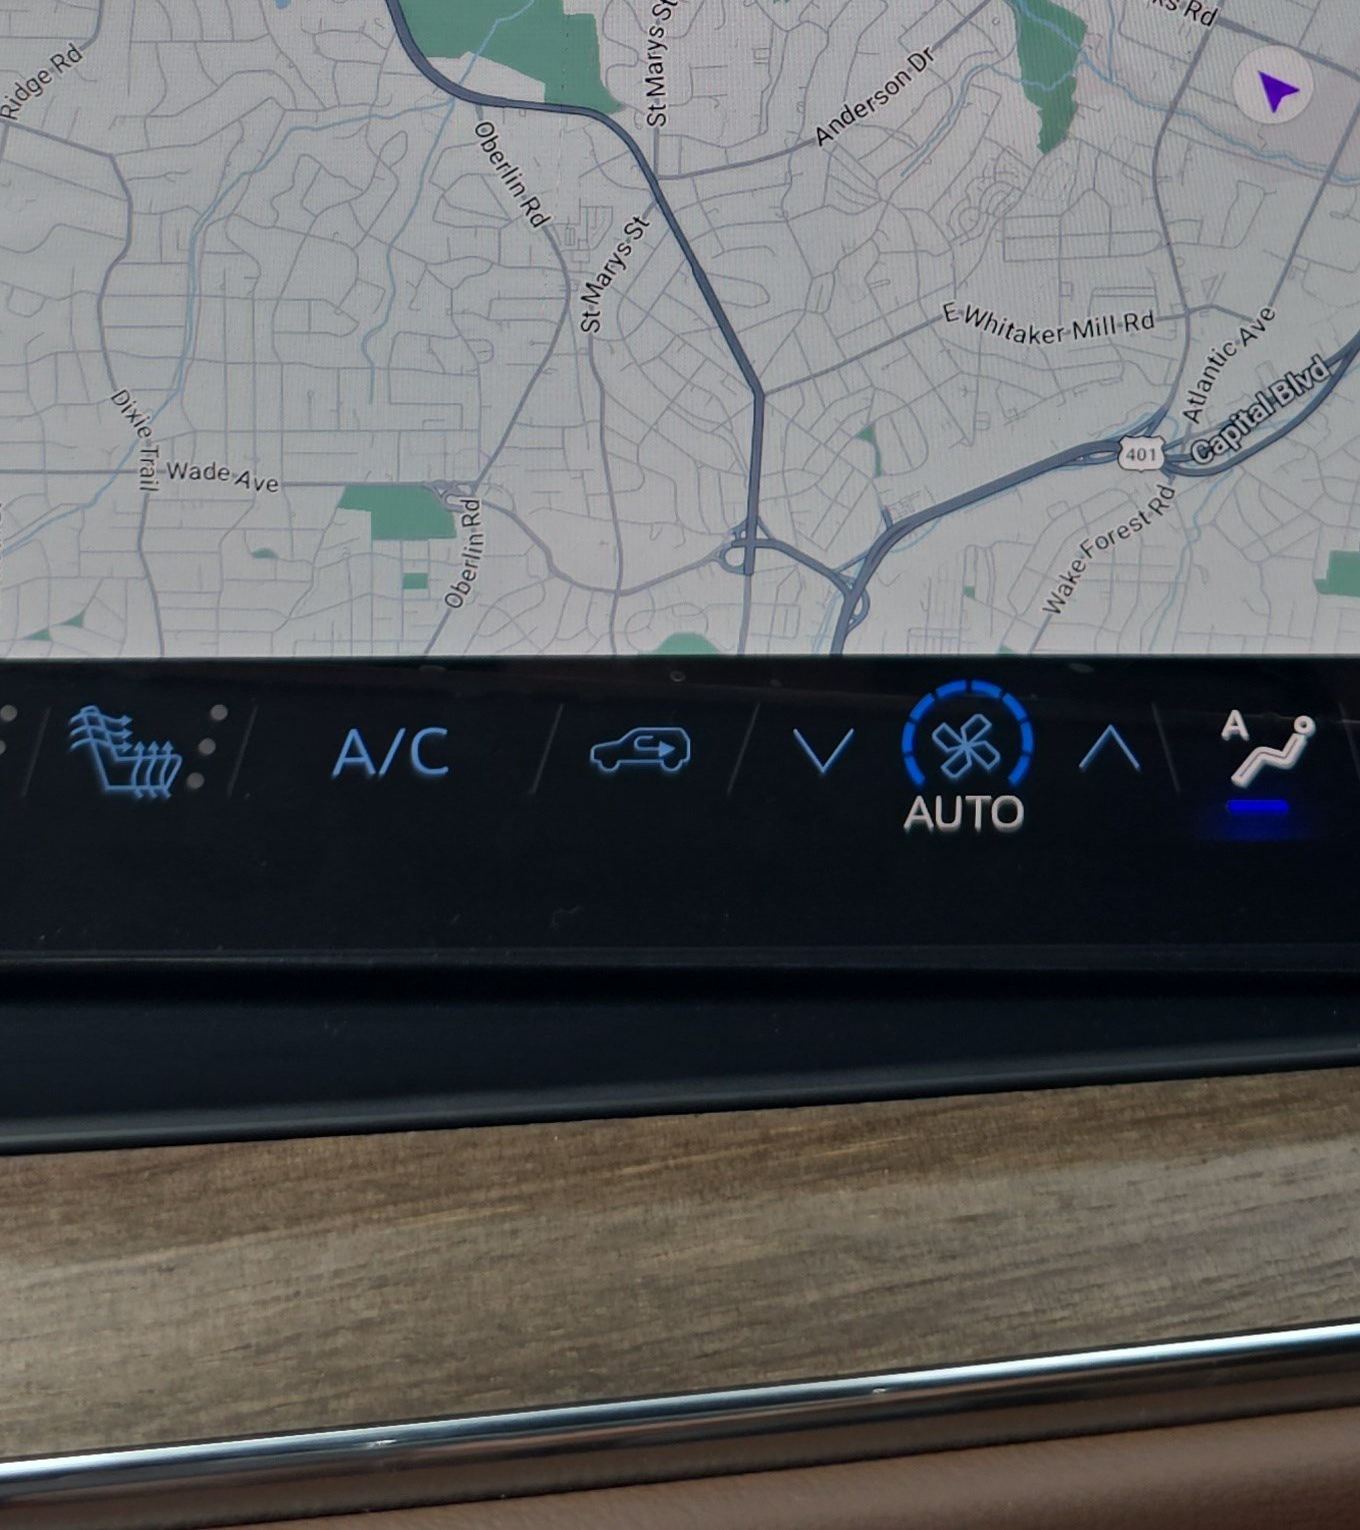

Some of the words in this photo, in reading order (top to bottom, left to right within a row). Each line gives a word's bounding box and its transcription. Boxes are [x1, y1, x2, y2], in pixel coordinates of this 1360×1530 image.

[1183, 0, 1218, 26] Rd
[0, 67, 46, 121] Ridge
[49, 44, 84, 78] Rd
[647, 26, 669, 98] Marys
[646, 102, 668, 128] St
[815, 72, 913, 147] Anderson
[906, 46, 935, 79] Dr
[476, 122, 527, 198] Oberlin
[520, 196, 549, 229] Rd
[623, 216, 651, 241] St
[581, 242, 632, 306] Marys
[581, 310, 602, 334] St
[942, 302, 959, 324] E
[965, 306, 1065, 345] Whitaker
[1072, 315, 1116, 338] Mill
[1124, 311, 1155, 331] Rd
[1183, 341, 1238, 425] Atlantic
[1238, 306, 1276, 347] Ave
[1190, 391, 1270, 467] Capital
[1270, 354, 1331, 409] Blvd
[110, 389, 152, 439] Dixie
[140, 447, 160, 493] Trail
[1126, 447, 1157, 462] 401
[166, 462, 231, 482] Wade
[234, 472, 279, 494] Ave
[462, 498, 479, 525] Rd
[445, 532, 484, 609] Oberlin
[1043, 560, 1087, 615] Wake
[1080, 512, 1151, 559] Forest
[1146, 484, 1176, 520] Rd
[1221, 710, 1250, 741] A
[332, 726, 449, 778] A/C
[902, 795, 1024, 831] AUTO
